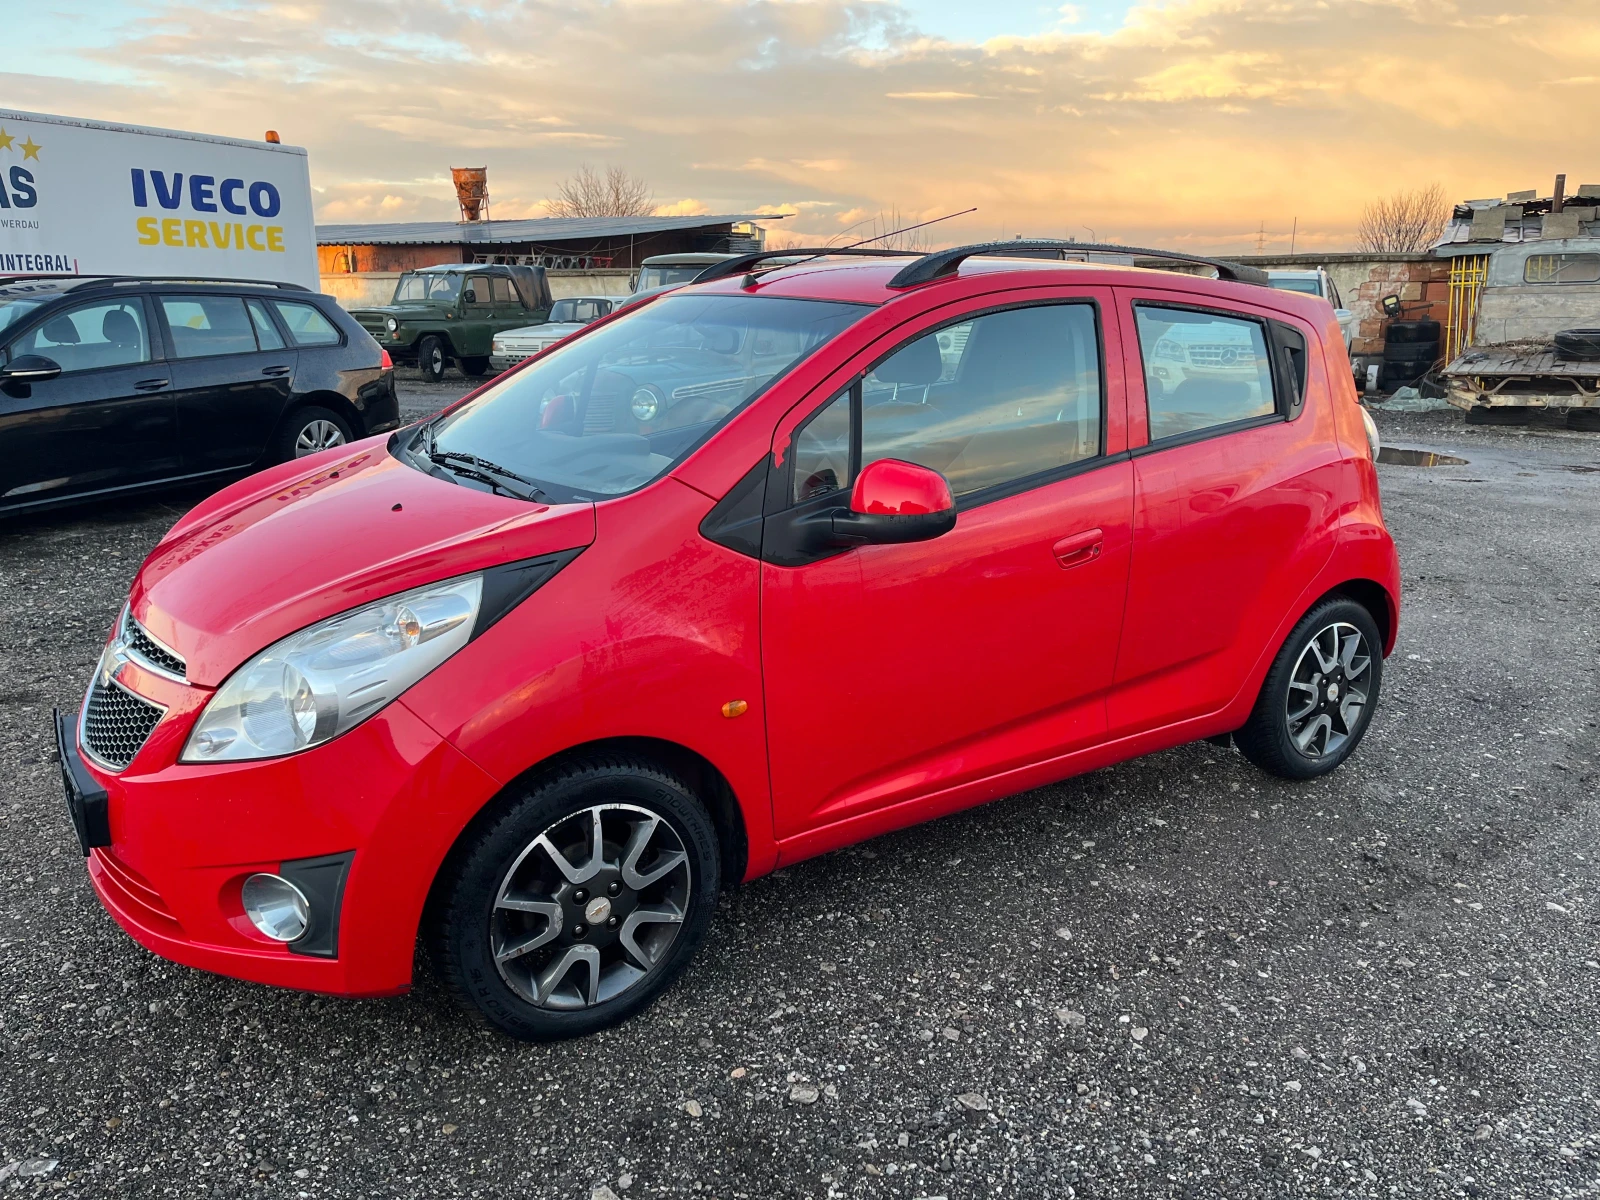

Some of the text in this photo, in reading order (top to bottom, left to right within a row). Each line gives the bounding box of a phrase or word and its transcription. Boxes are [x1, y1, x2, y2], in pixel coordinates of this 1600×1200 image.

[130, 168, 281, 217] IVECO
[1, 219, 39, 229] WERDAU
[136, 216, 286, 252] SERVICE
[0, 253, 72, 271] INTEGRAL
